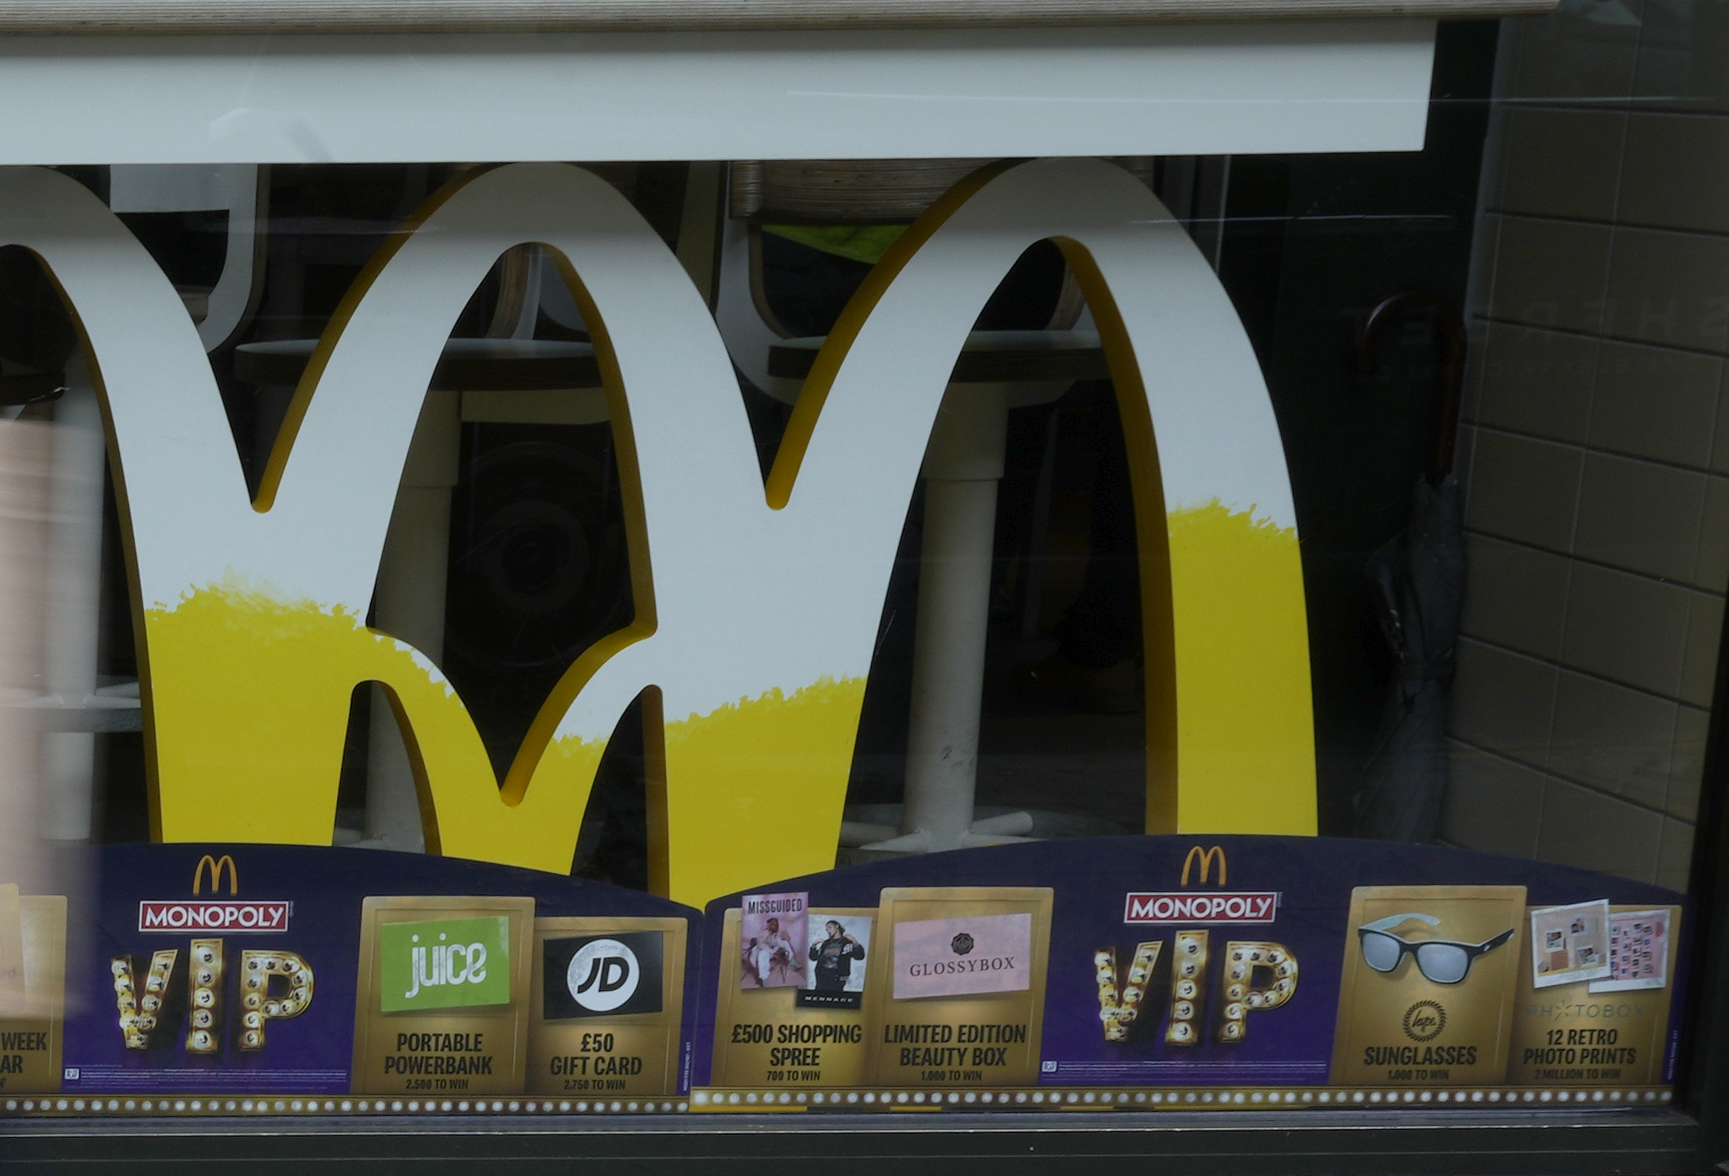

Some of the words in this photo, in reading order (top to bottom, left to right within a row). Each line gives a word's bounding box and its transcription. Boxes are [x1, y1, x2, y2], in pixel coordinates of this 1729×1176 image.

[145, 904, 285, 929] MONOPOLY
[747, 898, 803, 915] MISSGUIDED
[1130, 895, 1272, 920] MONOPOLY
[405, 933, 488, 999] juice
[576, 956, 630, 994] JD
[909, 956, 1017, 978] GLOSSYBOX
[111, 937, 315, 1054] VIP
[1094, 929, 1299, 1046] VIP
[1, 1032, 48, 1051] WEEK
[397, 1034, 483, 1053] PORTABLE
[580, 1033, 615, 1053] £50
[732, 1024, 774, 1045] £500
[777, 1024, 862, 1045] SHOPPING
[884, 1024, 953, 1044] LIMITED
[957, 1024, 1027, 1044] EDITION
[1547, 1029, 1563, 1045] 12
[1567, 1029, 1618, 1045] RETRO
[384, 1056, 493, 1076] POWERBANK
[550, 1056, 589, 1076] GIFT
[593, 1056, 642, 1076] CARD
[770, 1047, 820, 1067] SPREE
[900, 1047, 968, 1067] BEAUTY
[972, 1047, 1007, 1067] BOX
[1364, 1046, 1477, 1066] SUNGLASSES
[1524, 1048, 1576, 1065] PHOTO
[1580, 1048, 1637, 1065] PRINTS
[786, 1070, 798, 1082] TO
[800, 1070, 821, 1082] WIN
[948, 1070, 959, 1082] TO
[962, 1070, 983, 1082] WIN
[1414, 1069, 1426, 1080] TO
[1428, 1069, 1449, 1080] WIN
[1535, 1068, 1541, 1080] 2
[1543, 1068, 1582, 1080] MILLION
[1584, 1068, 1599, 1080] TO
[1602, 1068, 1621, 1080] WIN
[435, 1079, 446, 1091] TO
[448, 1079, 469, 1091] WIN
[593, 1079, 604, 1091] TO
[606, 1079, 626, 1091] WIN
